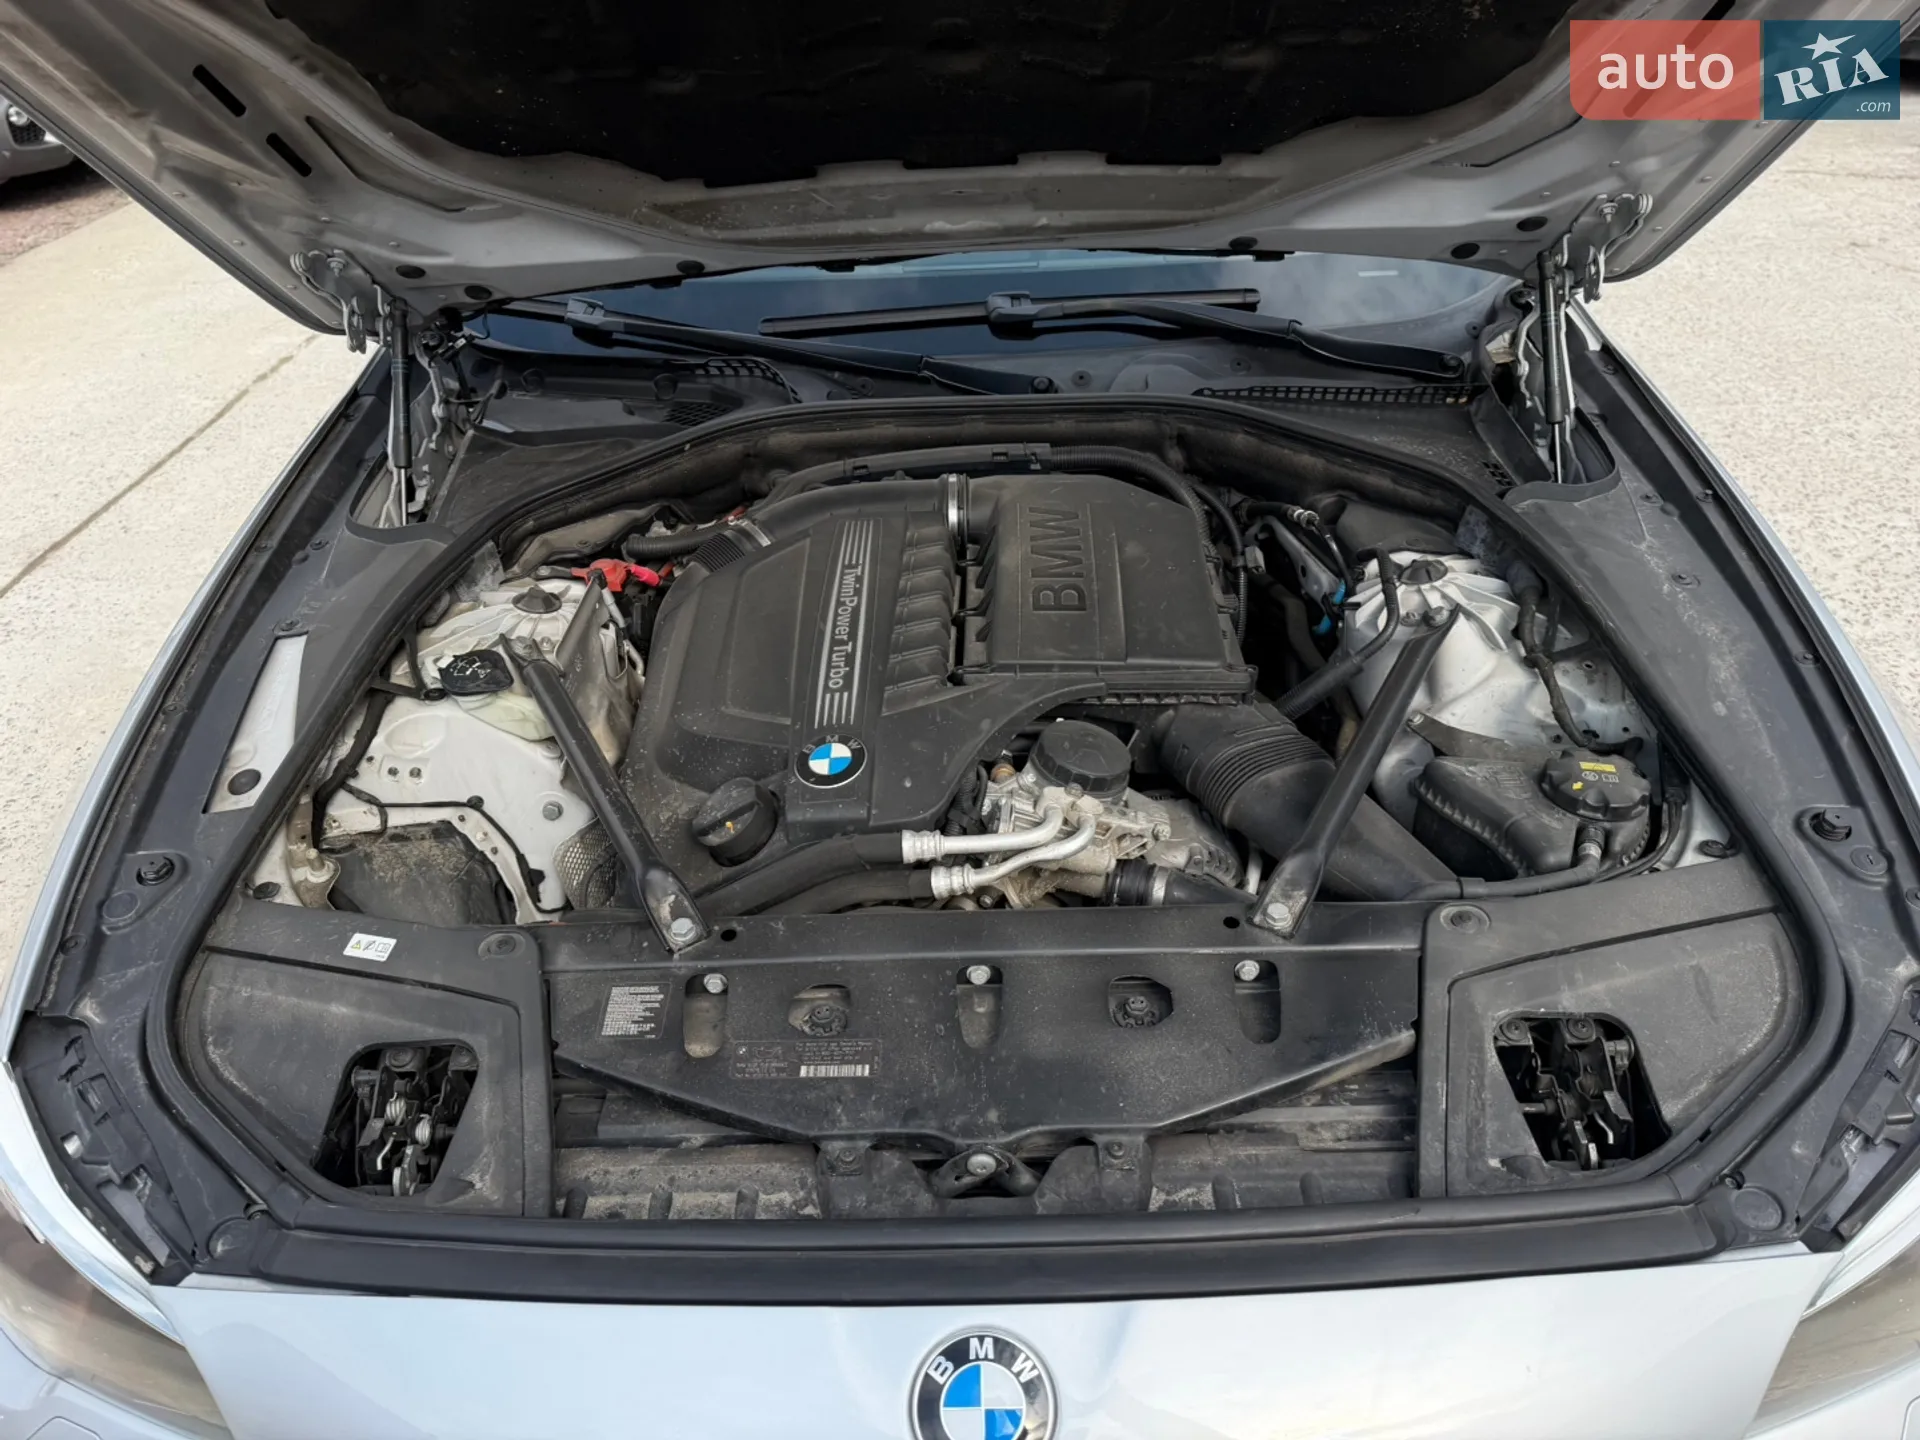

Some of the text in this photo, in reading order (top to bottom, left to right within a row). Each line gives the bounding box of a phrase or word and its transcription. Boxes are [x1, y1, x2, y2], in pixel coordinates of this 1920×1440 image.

[1028, 506, 1087, 612] BMW
[829, 565, 862, 688] TwinPower Turbo
[802, 735, 862, 754] BMW
[926, 1337, 1039, 1385] BMW
